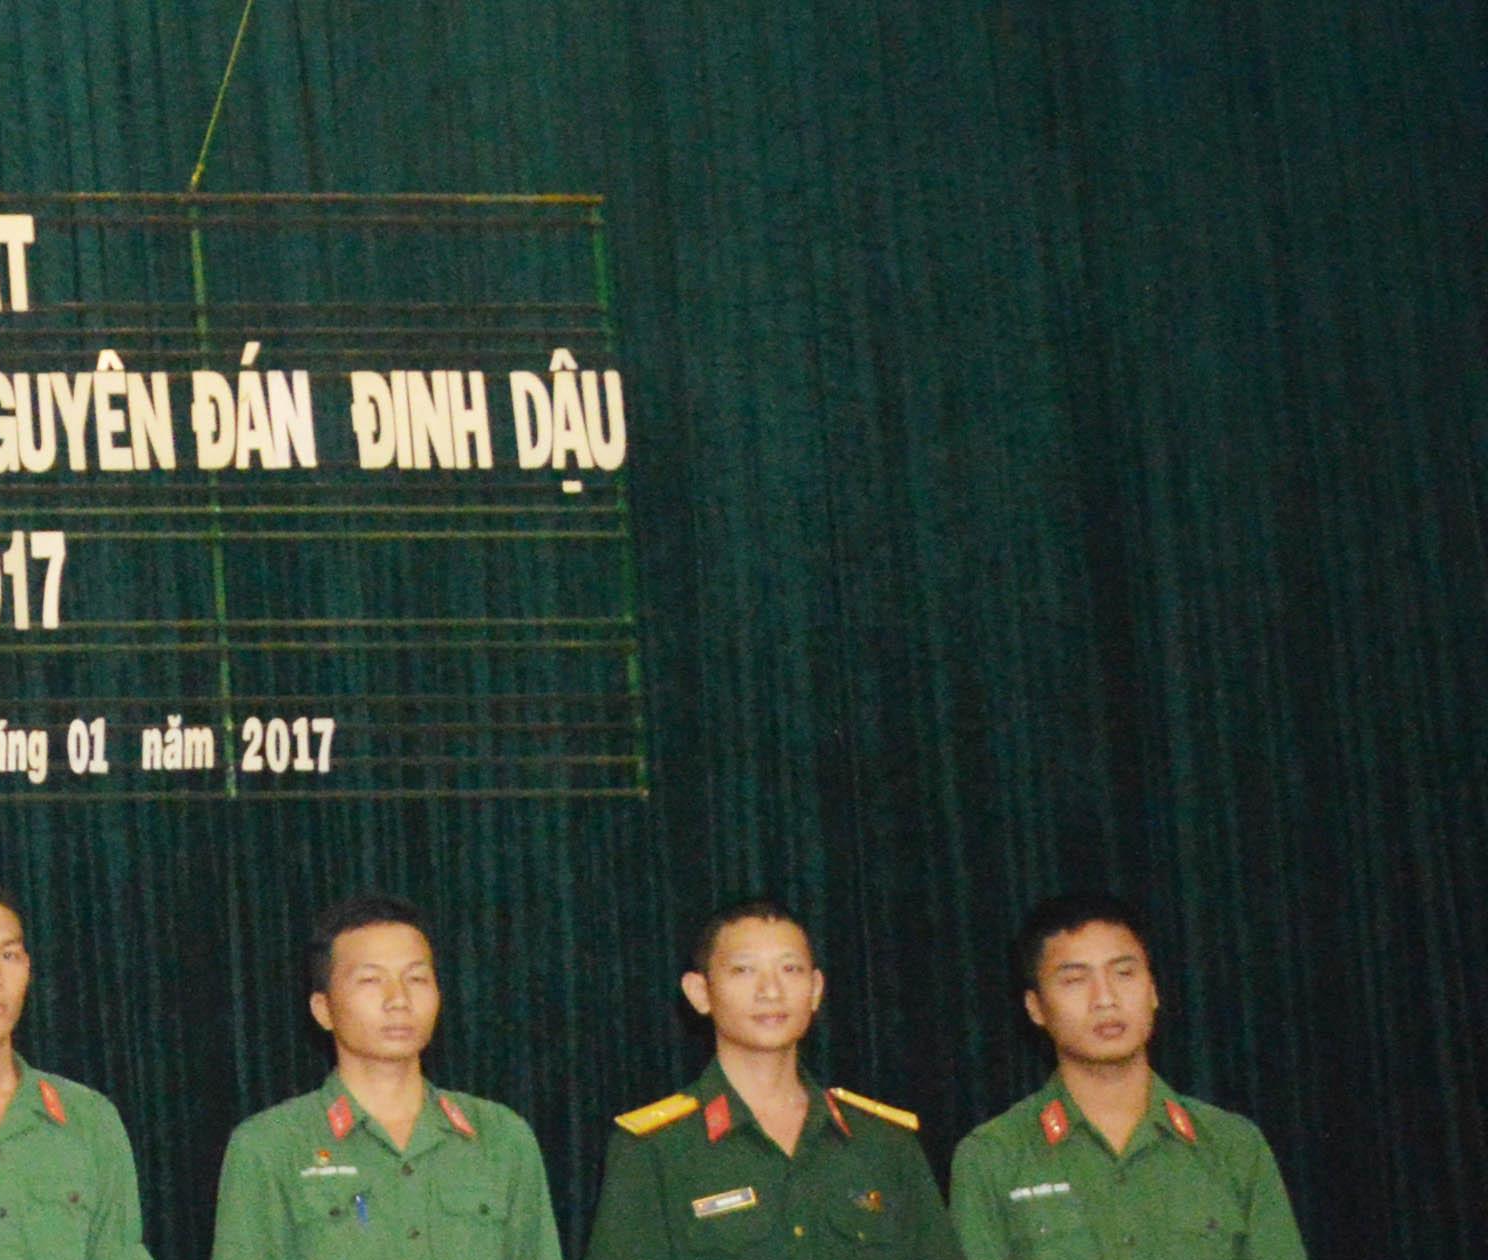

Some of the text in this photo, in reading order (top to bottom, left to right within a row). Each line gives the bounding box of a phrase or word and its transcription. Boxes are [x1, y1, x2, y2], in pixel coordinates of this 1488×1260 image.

[191, 341, 318, 470] ĐÁN
[350, 369, 493, 470] ĐINH
[509, 347, 627, 493] DẬU
[66, 716, 109, 775] 01
[141, 713, 215, 771] năm
[241, 716, 336, 774] 2017
